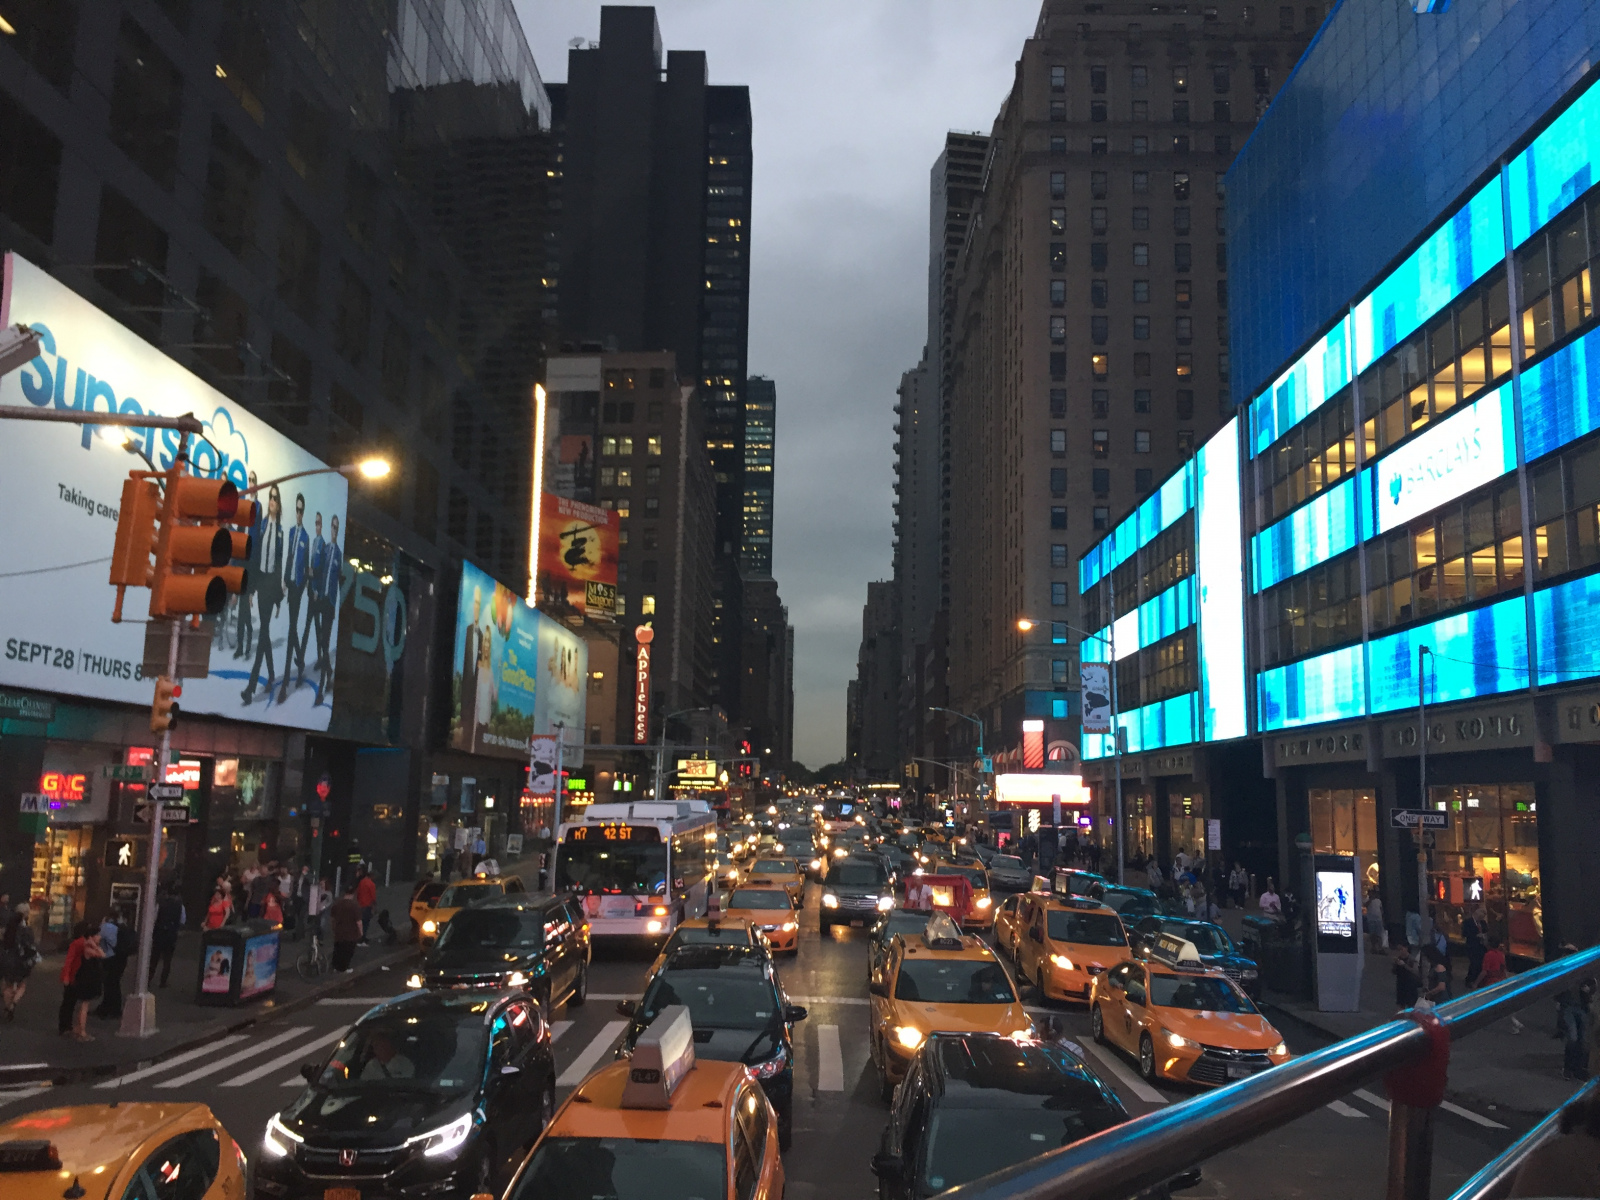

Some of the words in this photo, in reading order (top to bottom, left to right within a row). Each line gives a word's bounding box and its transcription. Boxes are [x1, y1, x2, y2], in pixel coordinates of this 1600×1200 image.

[20, 322, 248, 497] Superstore
[1406, 427, 1481, 494] BARCLAYS
[58, 482, 95, 517] Taking
[96, 502, 119, 523] care
[5, 638, 52, 665] SEPT
[52, 648, 75, 670] 28
[83, 652, 131, 680] THURS
[637, 647, 649, 741] Applebee's
[42, 773, 86, 792] GNC
[604, 827, 617, 840] 42
[619, 827, 633, 840] ST
[1400, 814, 1417, 823] ONE
[1423, 815, 1442, 824] WAY
